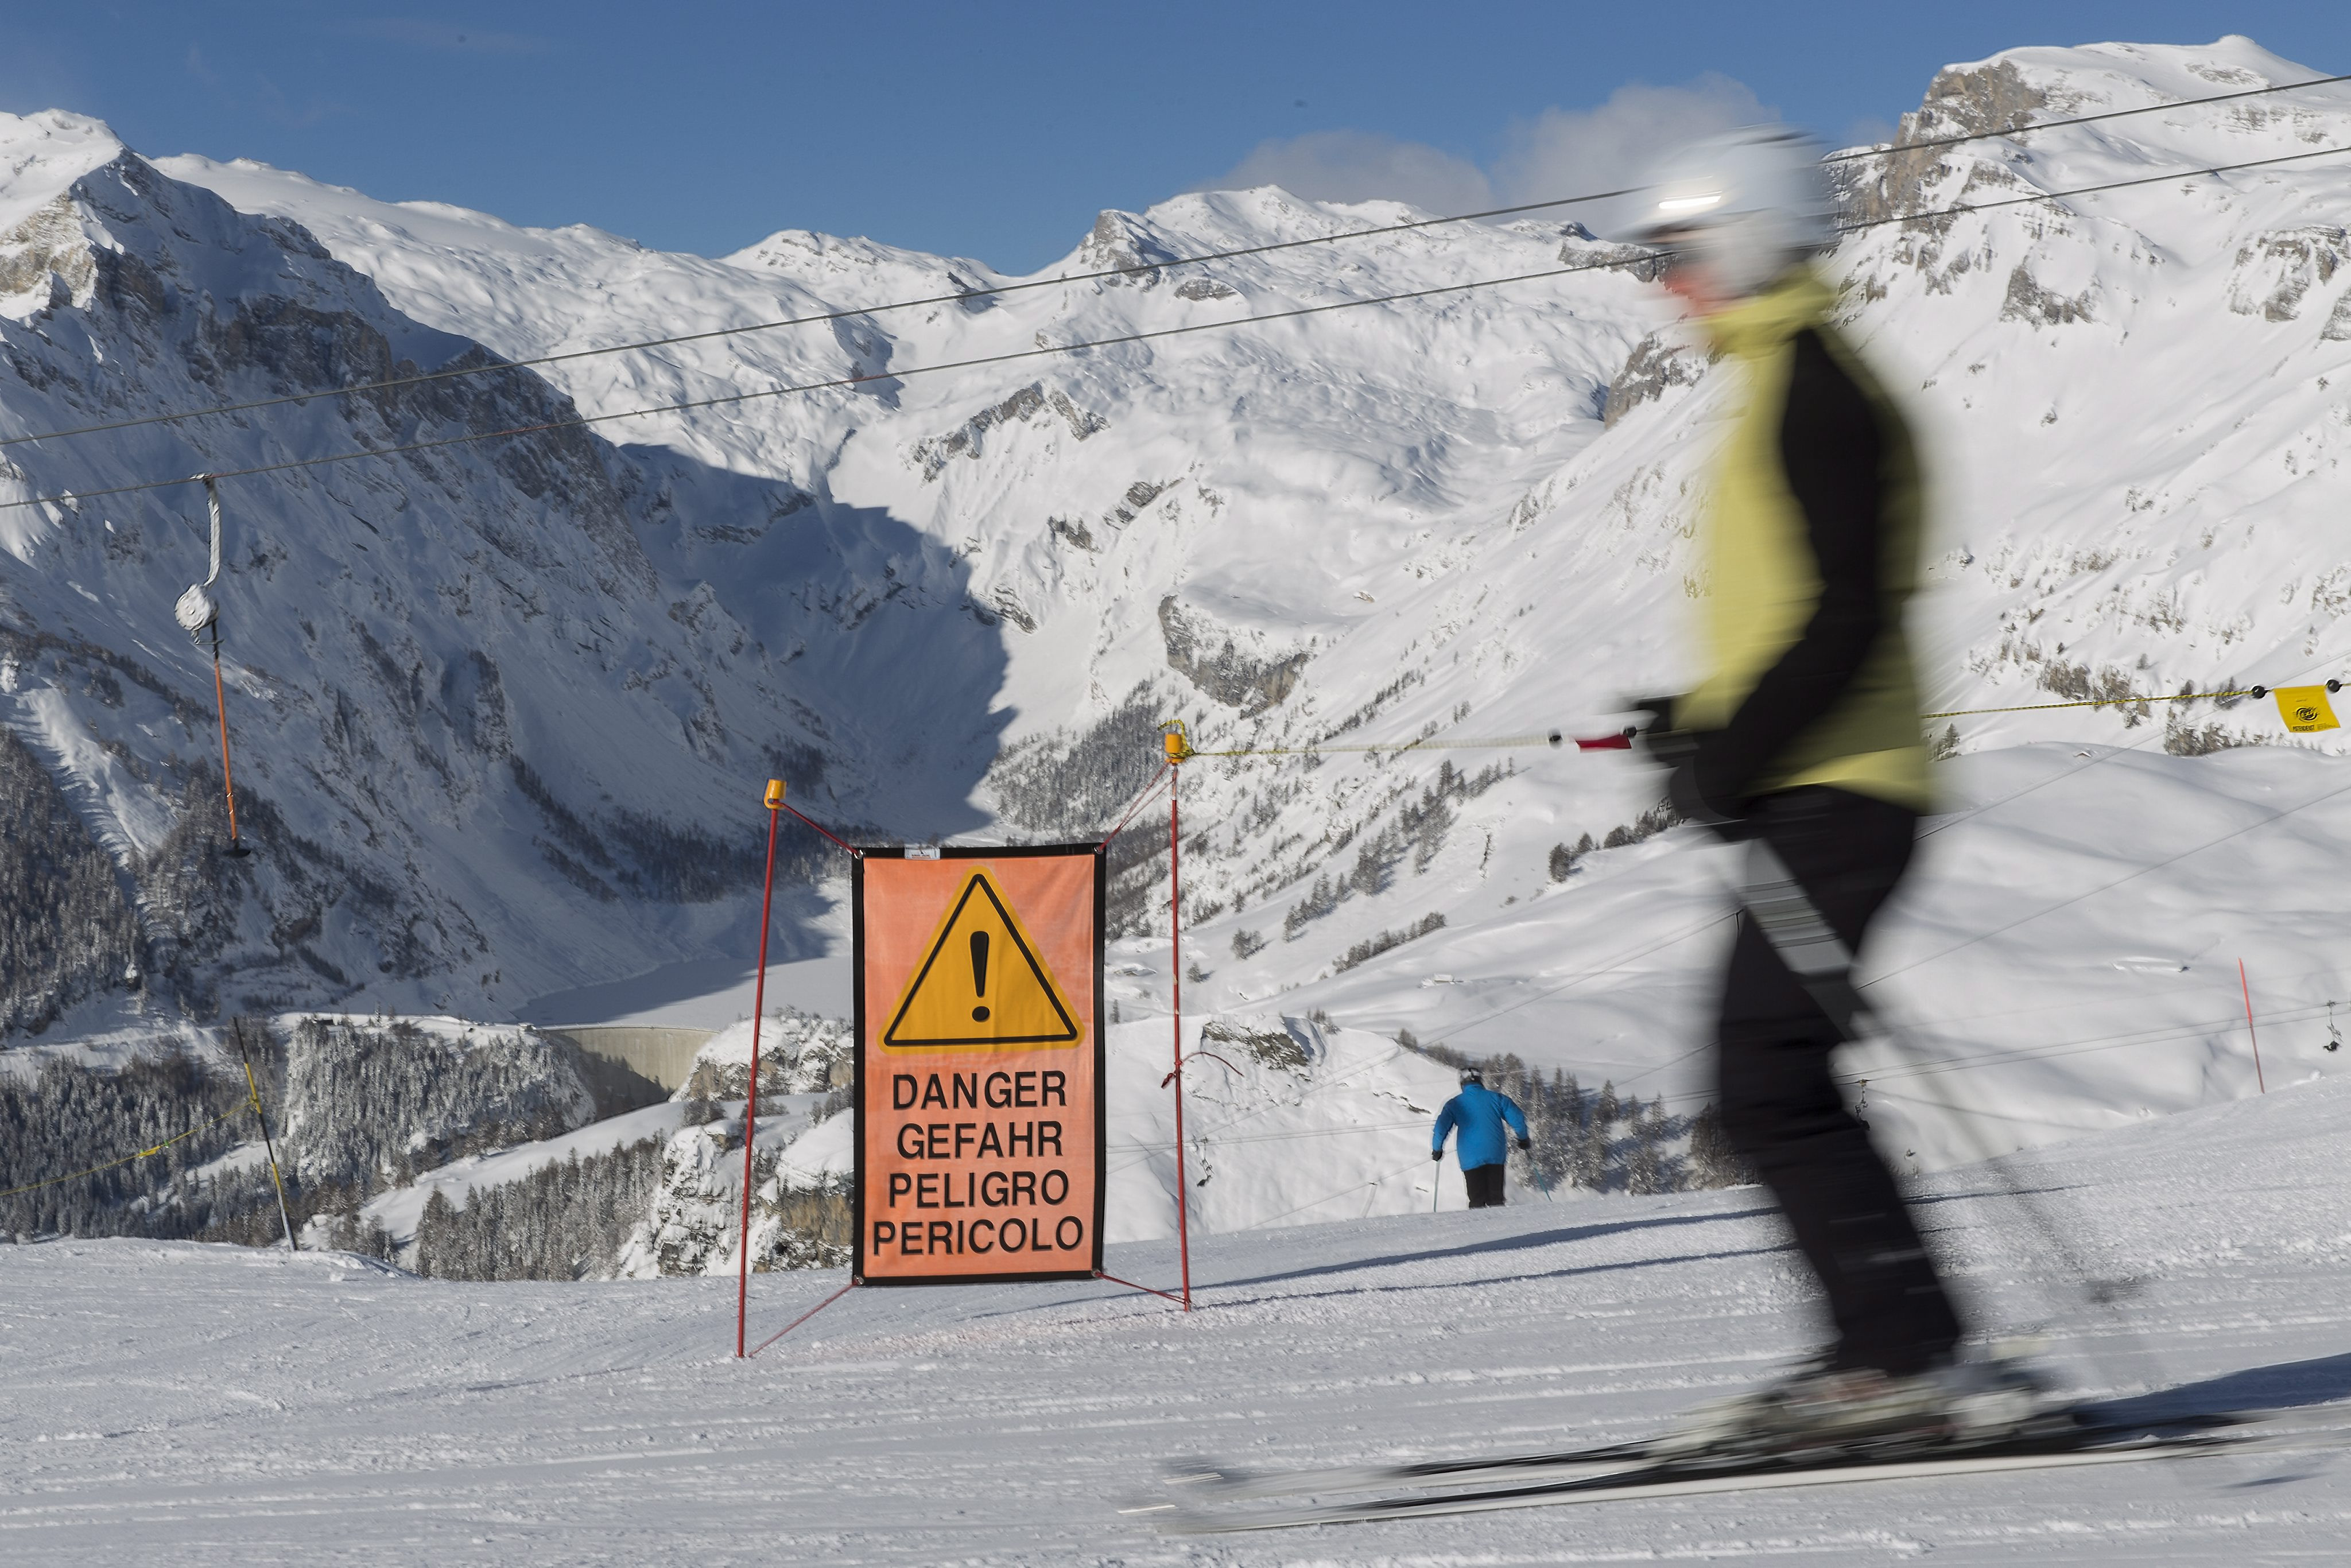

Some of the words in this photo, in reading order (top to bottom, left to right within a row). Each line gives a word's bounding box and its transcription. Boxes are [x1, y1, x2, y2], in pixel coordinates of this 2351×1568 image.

[893, 1070, 1066, 1110] DANGER
[897, 1120, 1063, 1159] GEFAHR
[889, 1169, 1069, 1209] PELIGRO
[874, 1216, 1083, 1256] PERICOLO
